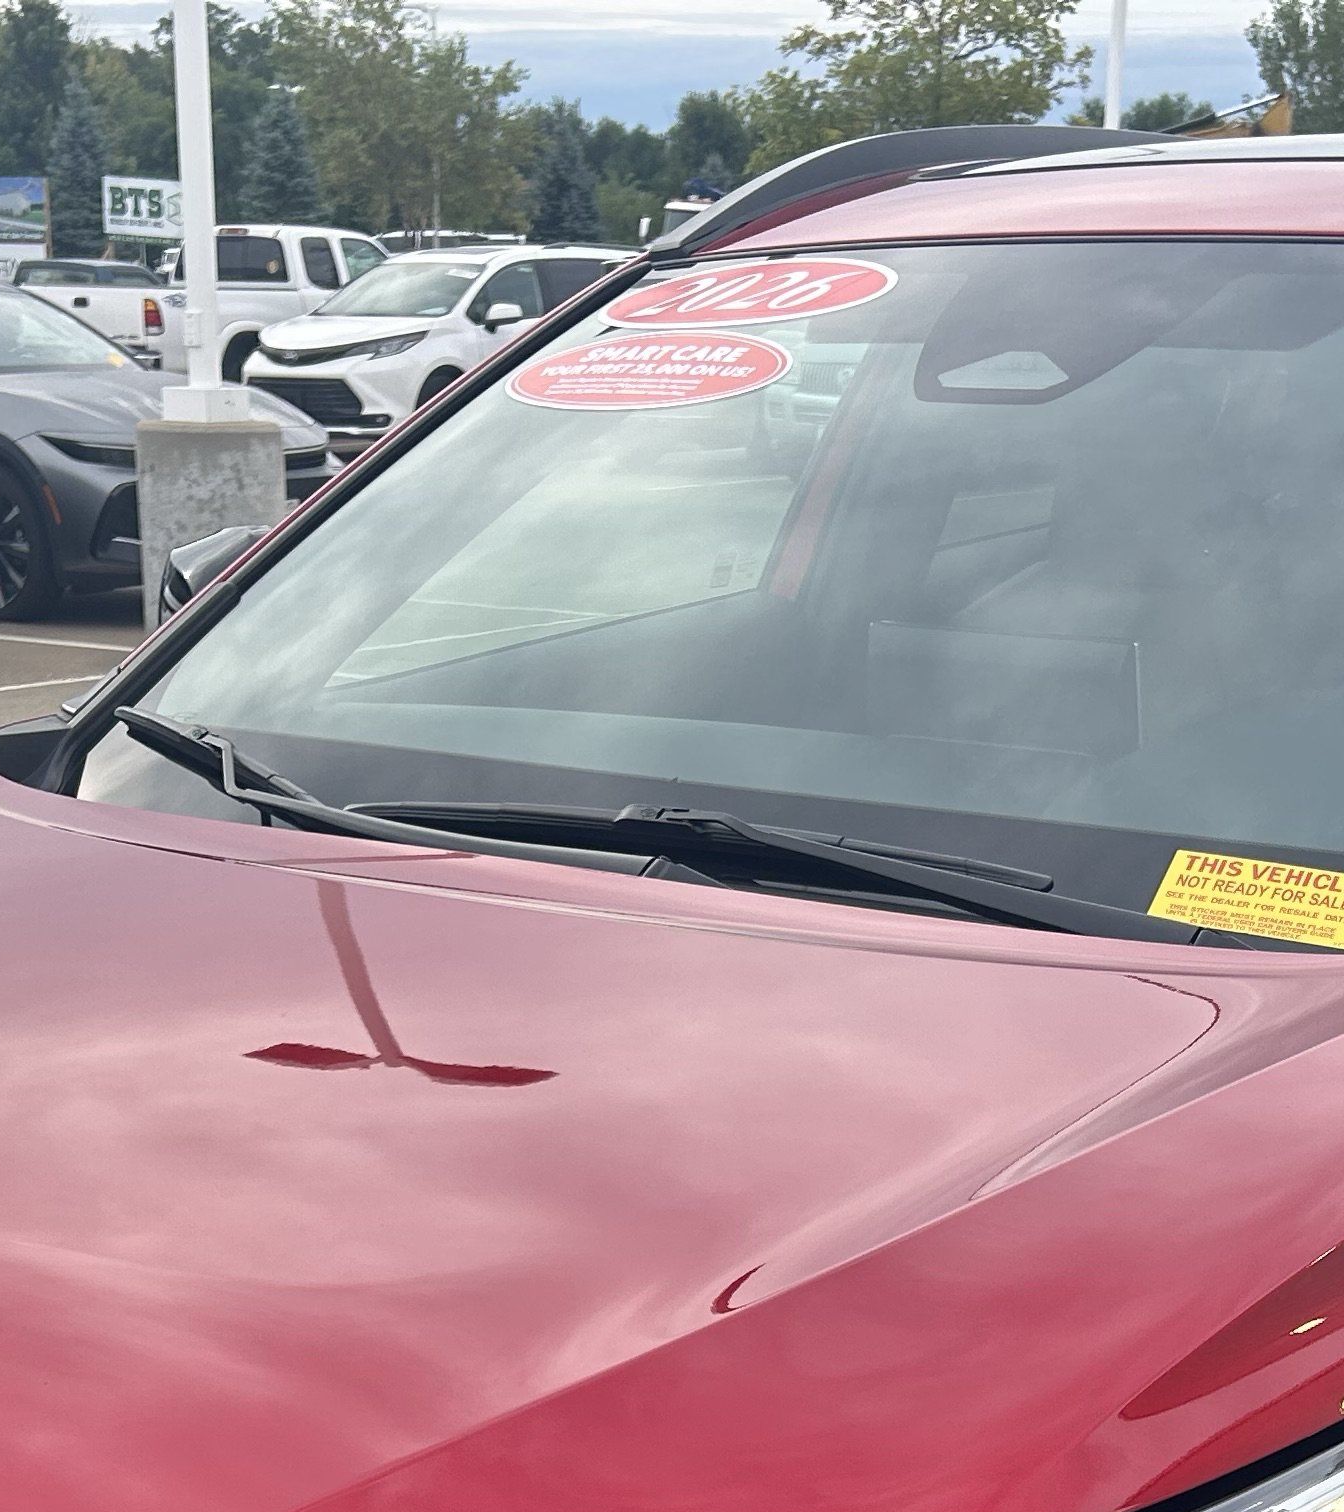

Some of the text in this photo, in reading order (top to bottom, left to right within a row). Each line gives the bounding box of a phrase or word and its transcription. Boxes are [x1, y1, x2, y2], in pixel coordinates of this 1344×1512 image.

[109, 186, 164, 219] BTS
[622, 269, 873, 319] 2026
[579, 345, 751, 363] SMART CARE
[583, 363, 632, 376] FIRST
[689, 364, 726, 377] ON
[1185, 854, 1244, 877] THIS
[1175, 874, 1211, 890] NOT
[1211, 879, 1271, 898] READY
[1271, 888, 1306, 904] FOR
[1165, 890, 1185, 899] SEE
[1188, 893, 1208, 902] THE
[1210, 897, 1250, 909] DEALER
[1254, 903, 1275, 912] FOR
[1279, 906, 1320, 919] RESALE
